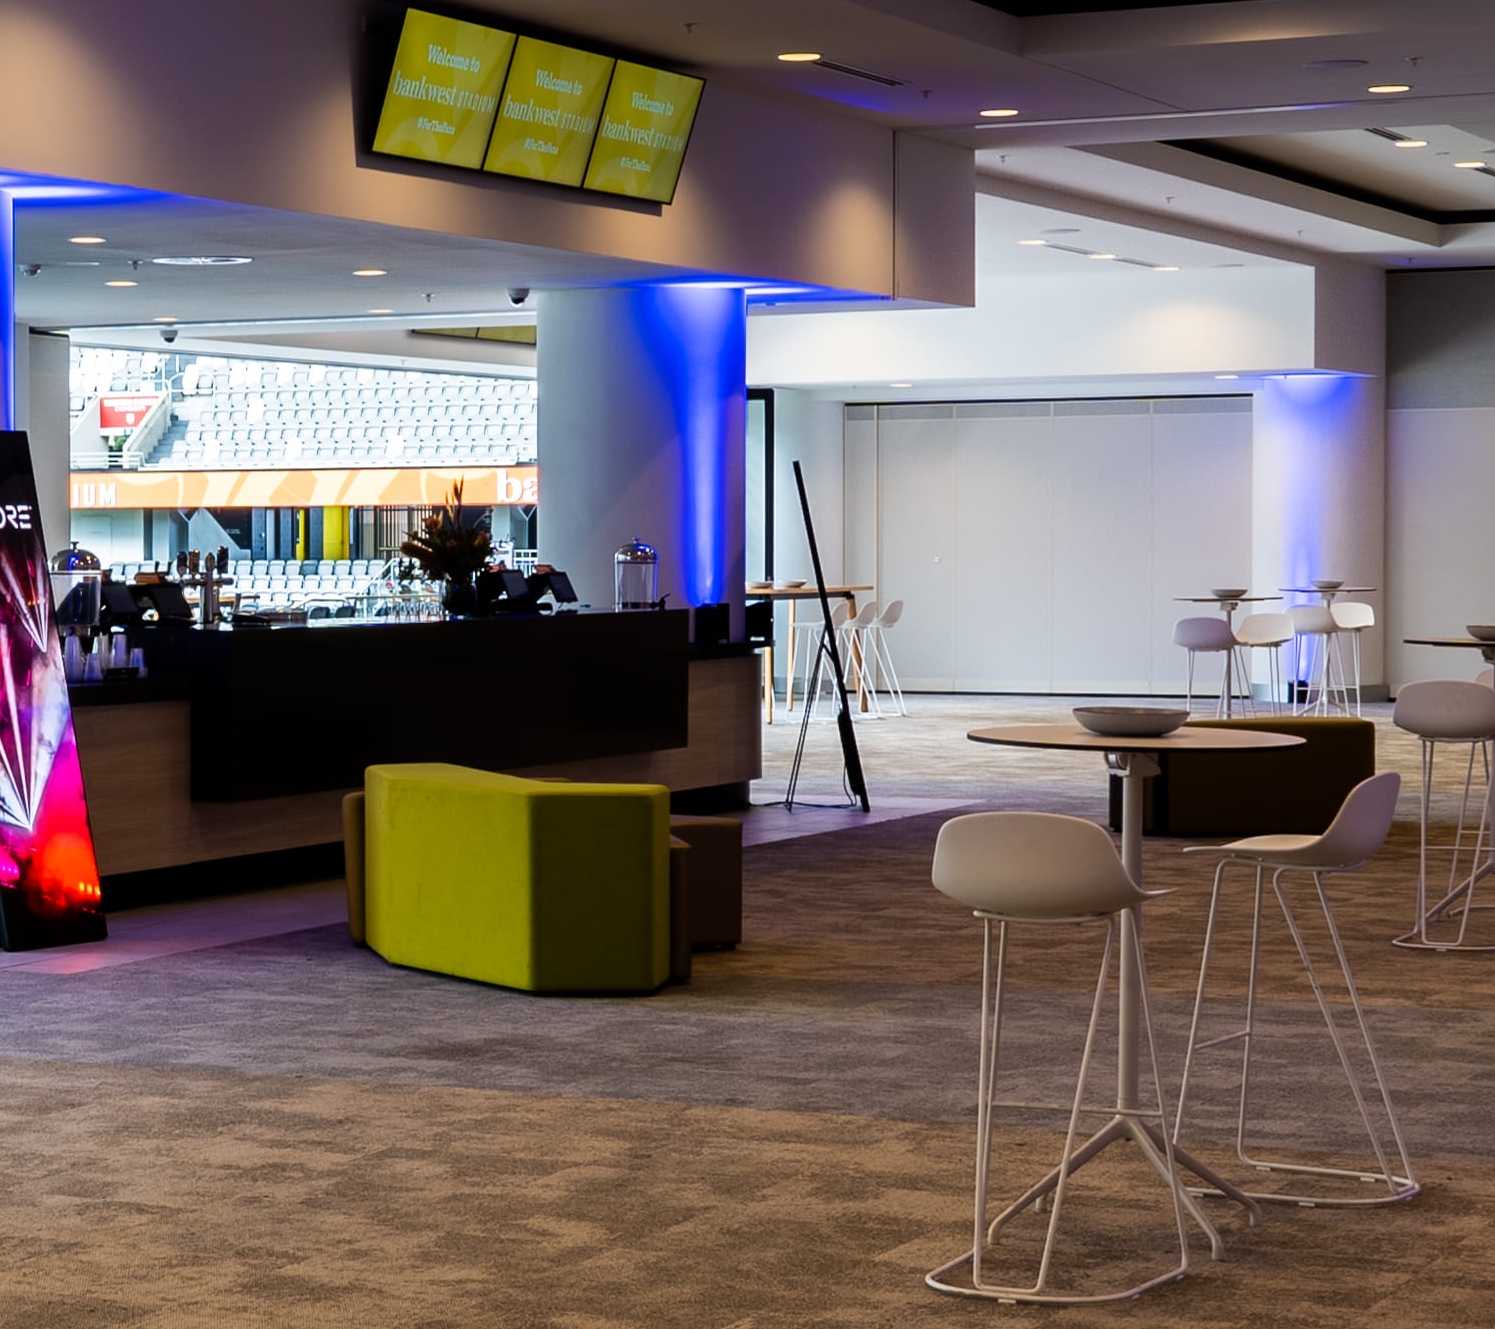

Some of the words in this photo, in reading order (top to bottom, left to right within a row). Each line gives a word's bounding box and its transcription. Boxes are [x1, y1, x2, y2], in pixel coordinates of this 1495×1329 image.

[428, 44, 469, 71] Welcome
[470, 56, 480, 73] to
[393, 71, 456, 105] bankwest
[457, 90, 495, 112] STADIUM
[536, 69, 572, 93] Welcome
[573, 80, 582, 95] to
[504, 95, 561, 127] bankwest
[632, 92, 665, 114] Welcome
[602, 115, 654, 146] bankwest
